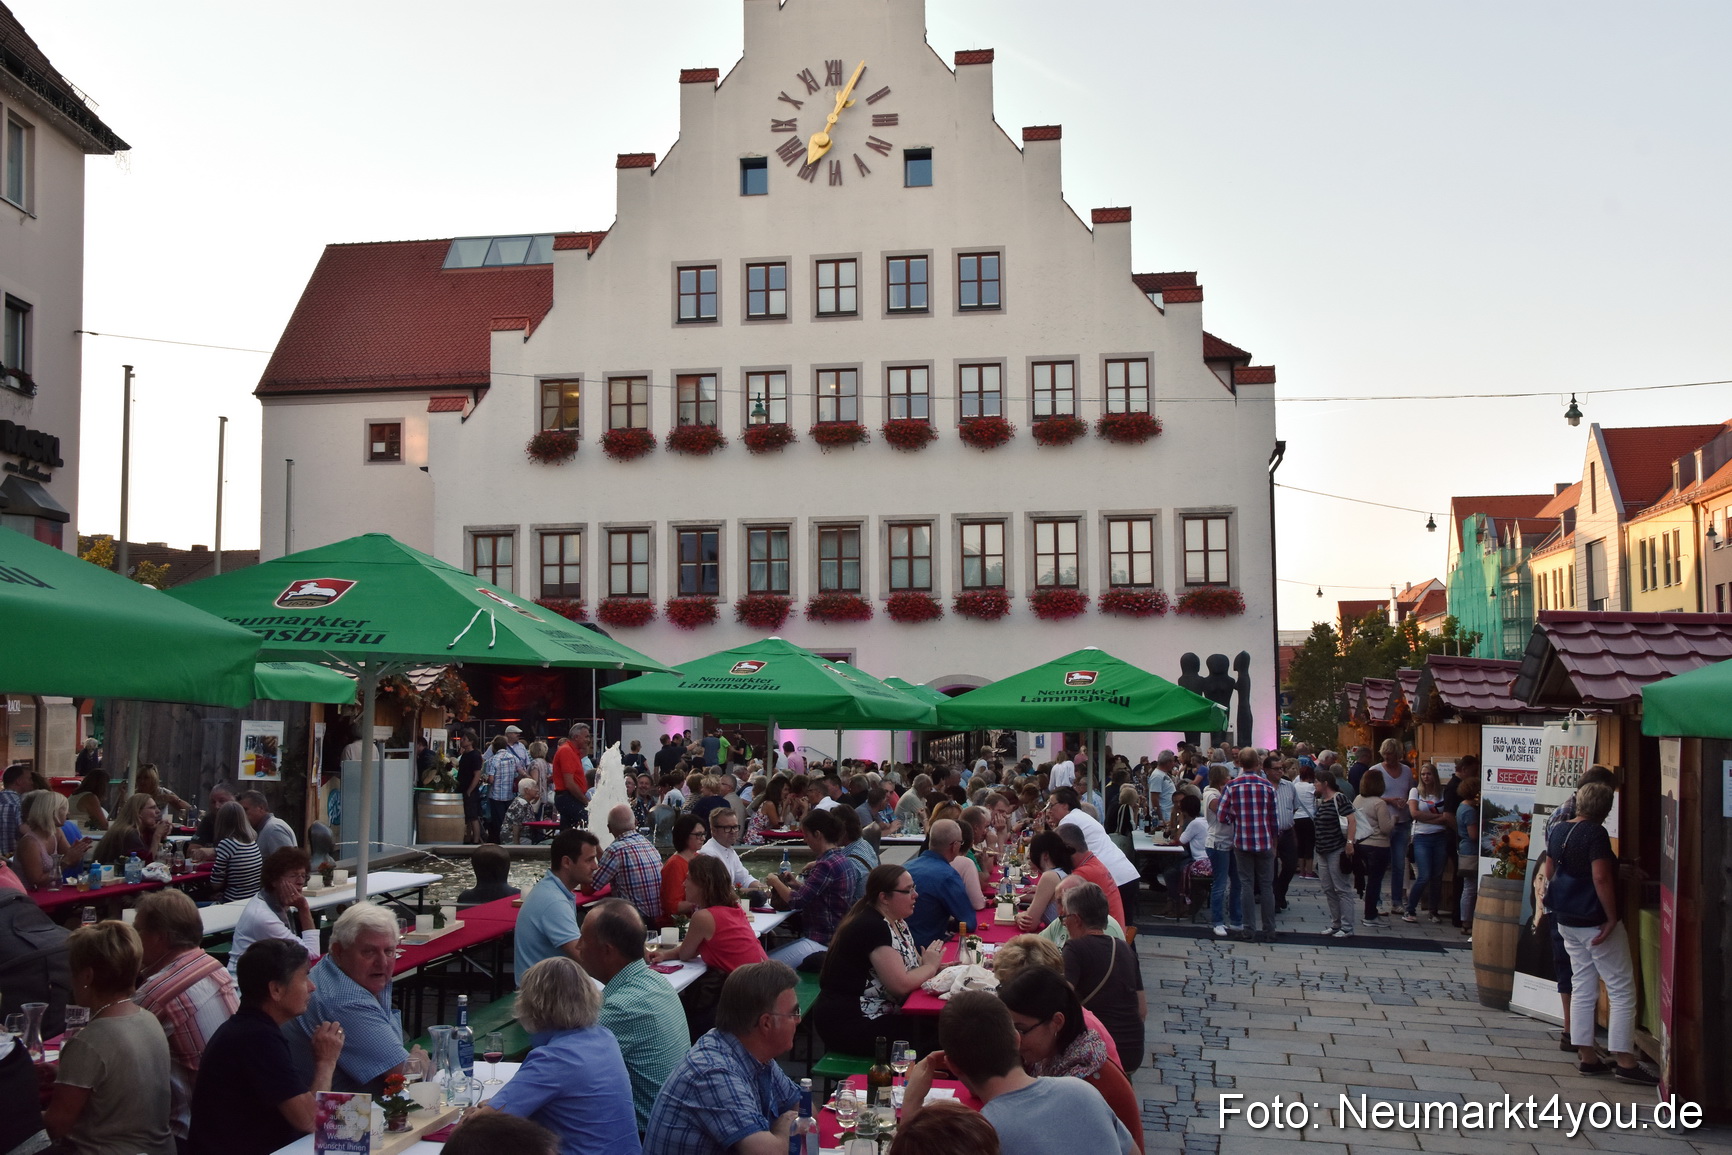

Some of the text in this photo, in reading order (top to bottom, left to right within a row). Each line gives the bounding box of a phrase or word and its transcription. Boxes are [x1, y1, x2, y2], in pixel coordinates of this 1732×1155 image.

[777, 90, 804, 111] X
[698, 676, 775, 684] Neumarkter
[677, 681, 781, 691] Lammsbräu
[1492, 744, 1505, 753] UND
[1505, 745, 1517, 754] WO
[1517, 745, 1527, 754] SIE
[346, 1143, 367, 1152] Ihnen
